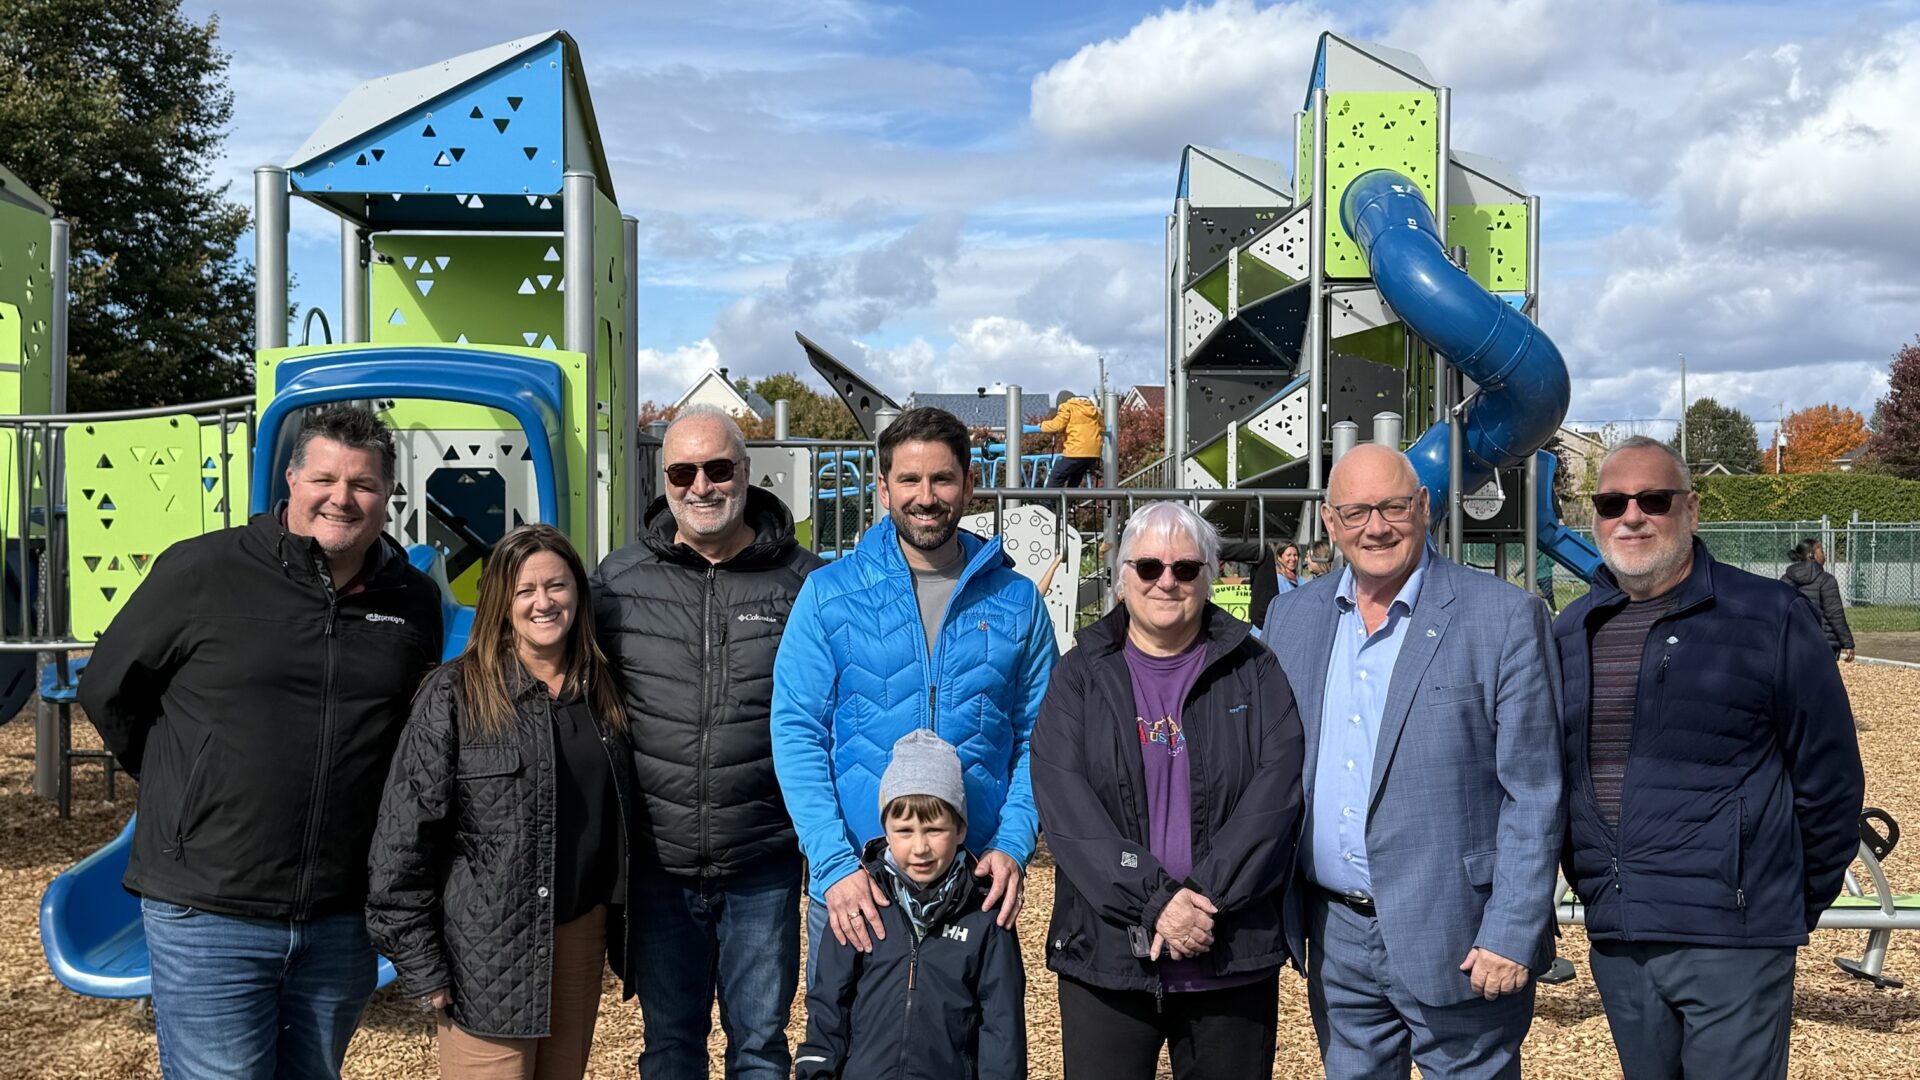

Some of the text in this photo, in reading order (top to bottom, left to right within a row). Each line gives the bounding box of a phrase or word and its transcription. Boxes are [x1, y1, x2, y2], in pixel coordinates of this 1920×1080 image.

[1214, 585, 1251, 593] OUVEZ-L
[745, 613, 777, 623] Columbia
[942, 923, 969, 942] HH
